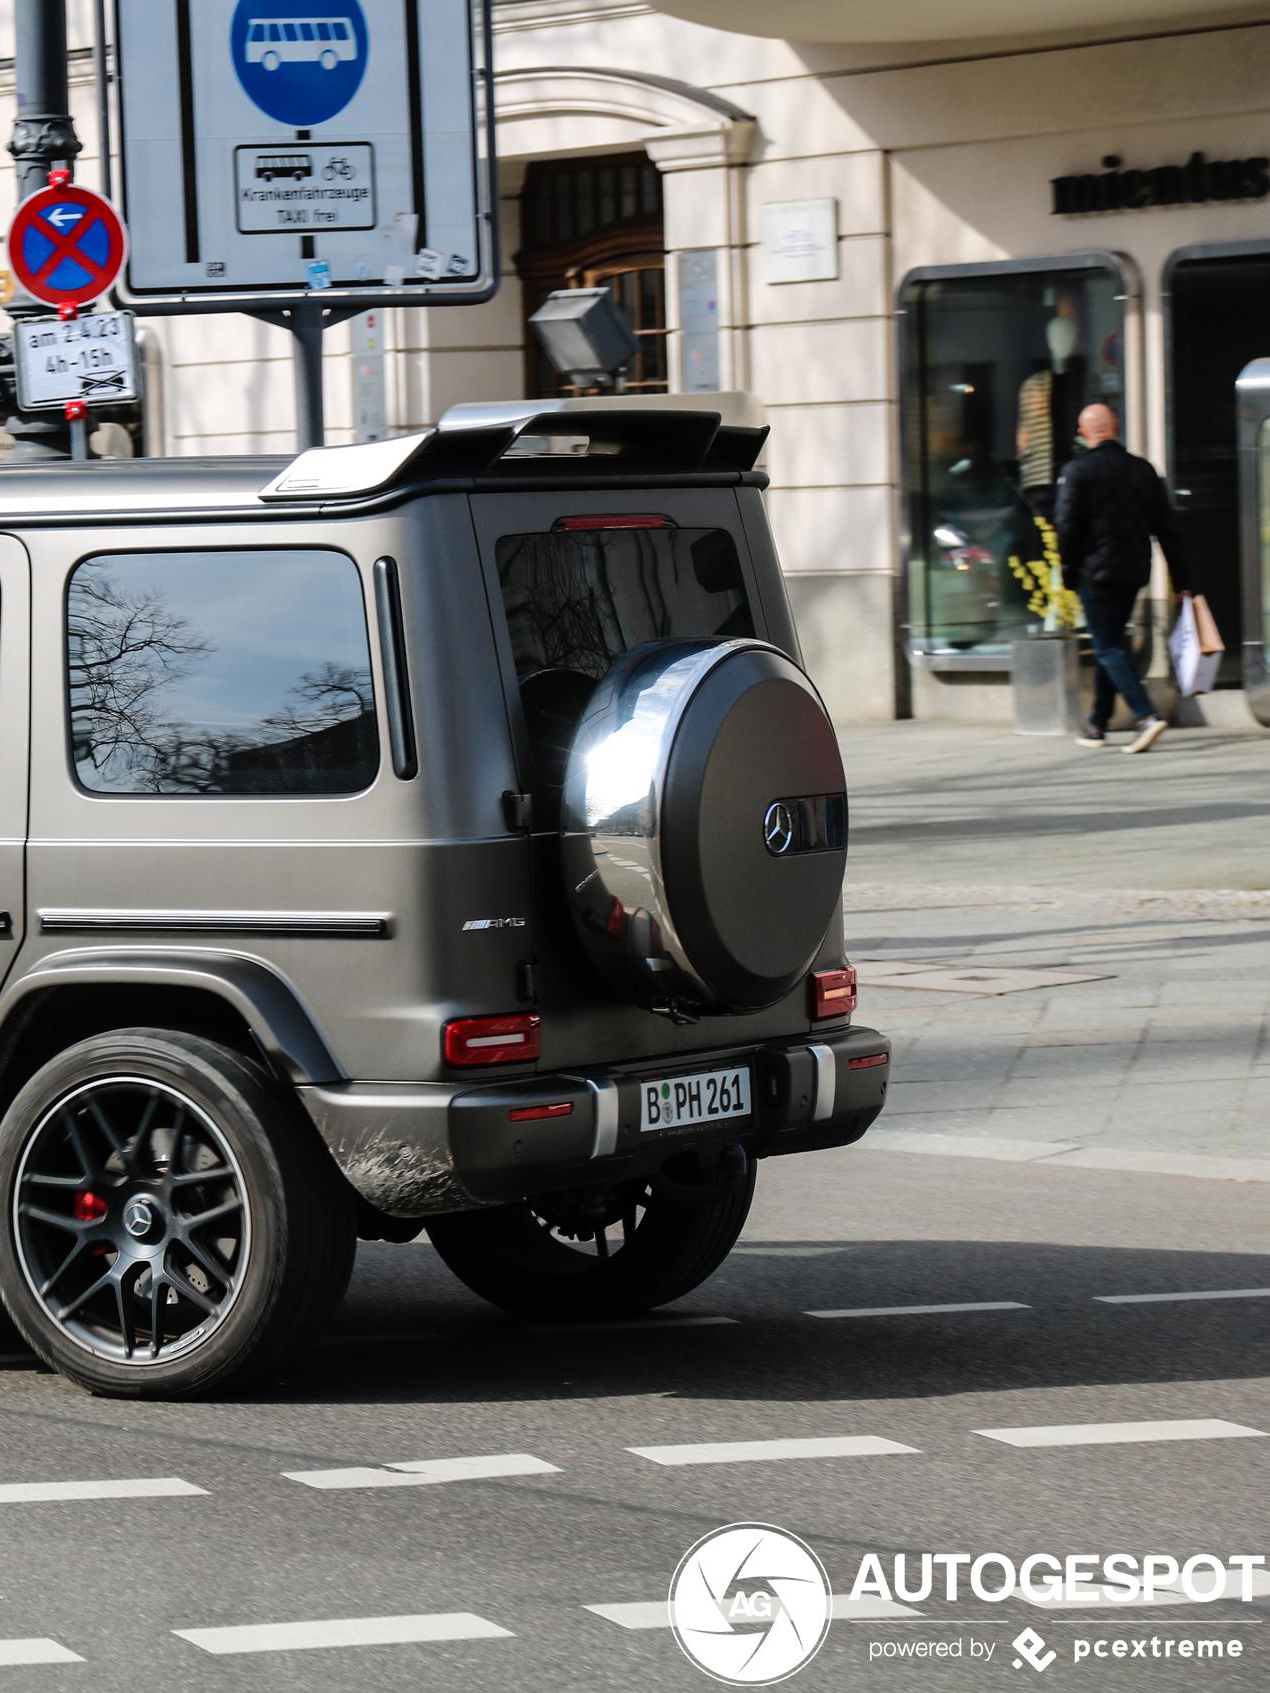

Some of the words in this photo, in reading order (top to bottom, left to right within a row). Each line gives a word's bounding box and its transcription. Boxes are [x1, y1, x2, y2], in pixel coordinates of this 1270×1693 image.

[240, 186, 369, 202] Krankenfahrzeuge
[276, 209, 309, 224] TAXI
[312, 208, 339, 222] frei
[30, 332, 58, 348] am
[647, 1086, 660, 1125] B
[674, 1080, 702, 1120] PH
[706, 1073, 744, 1116] 261
